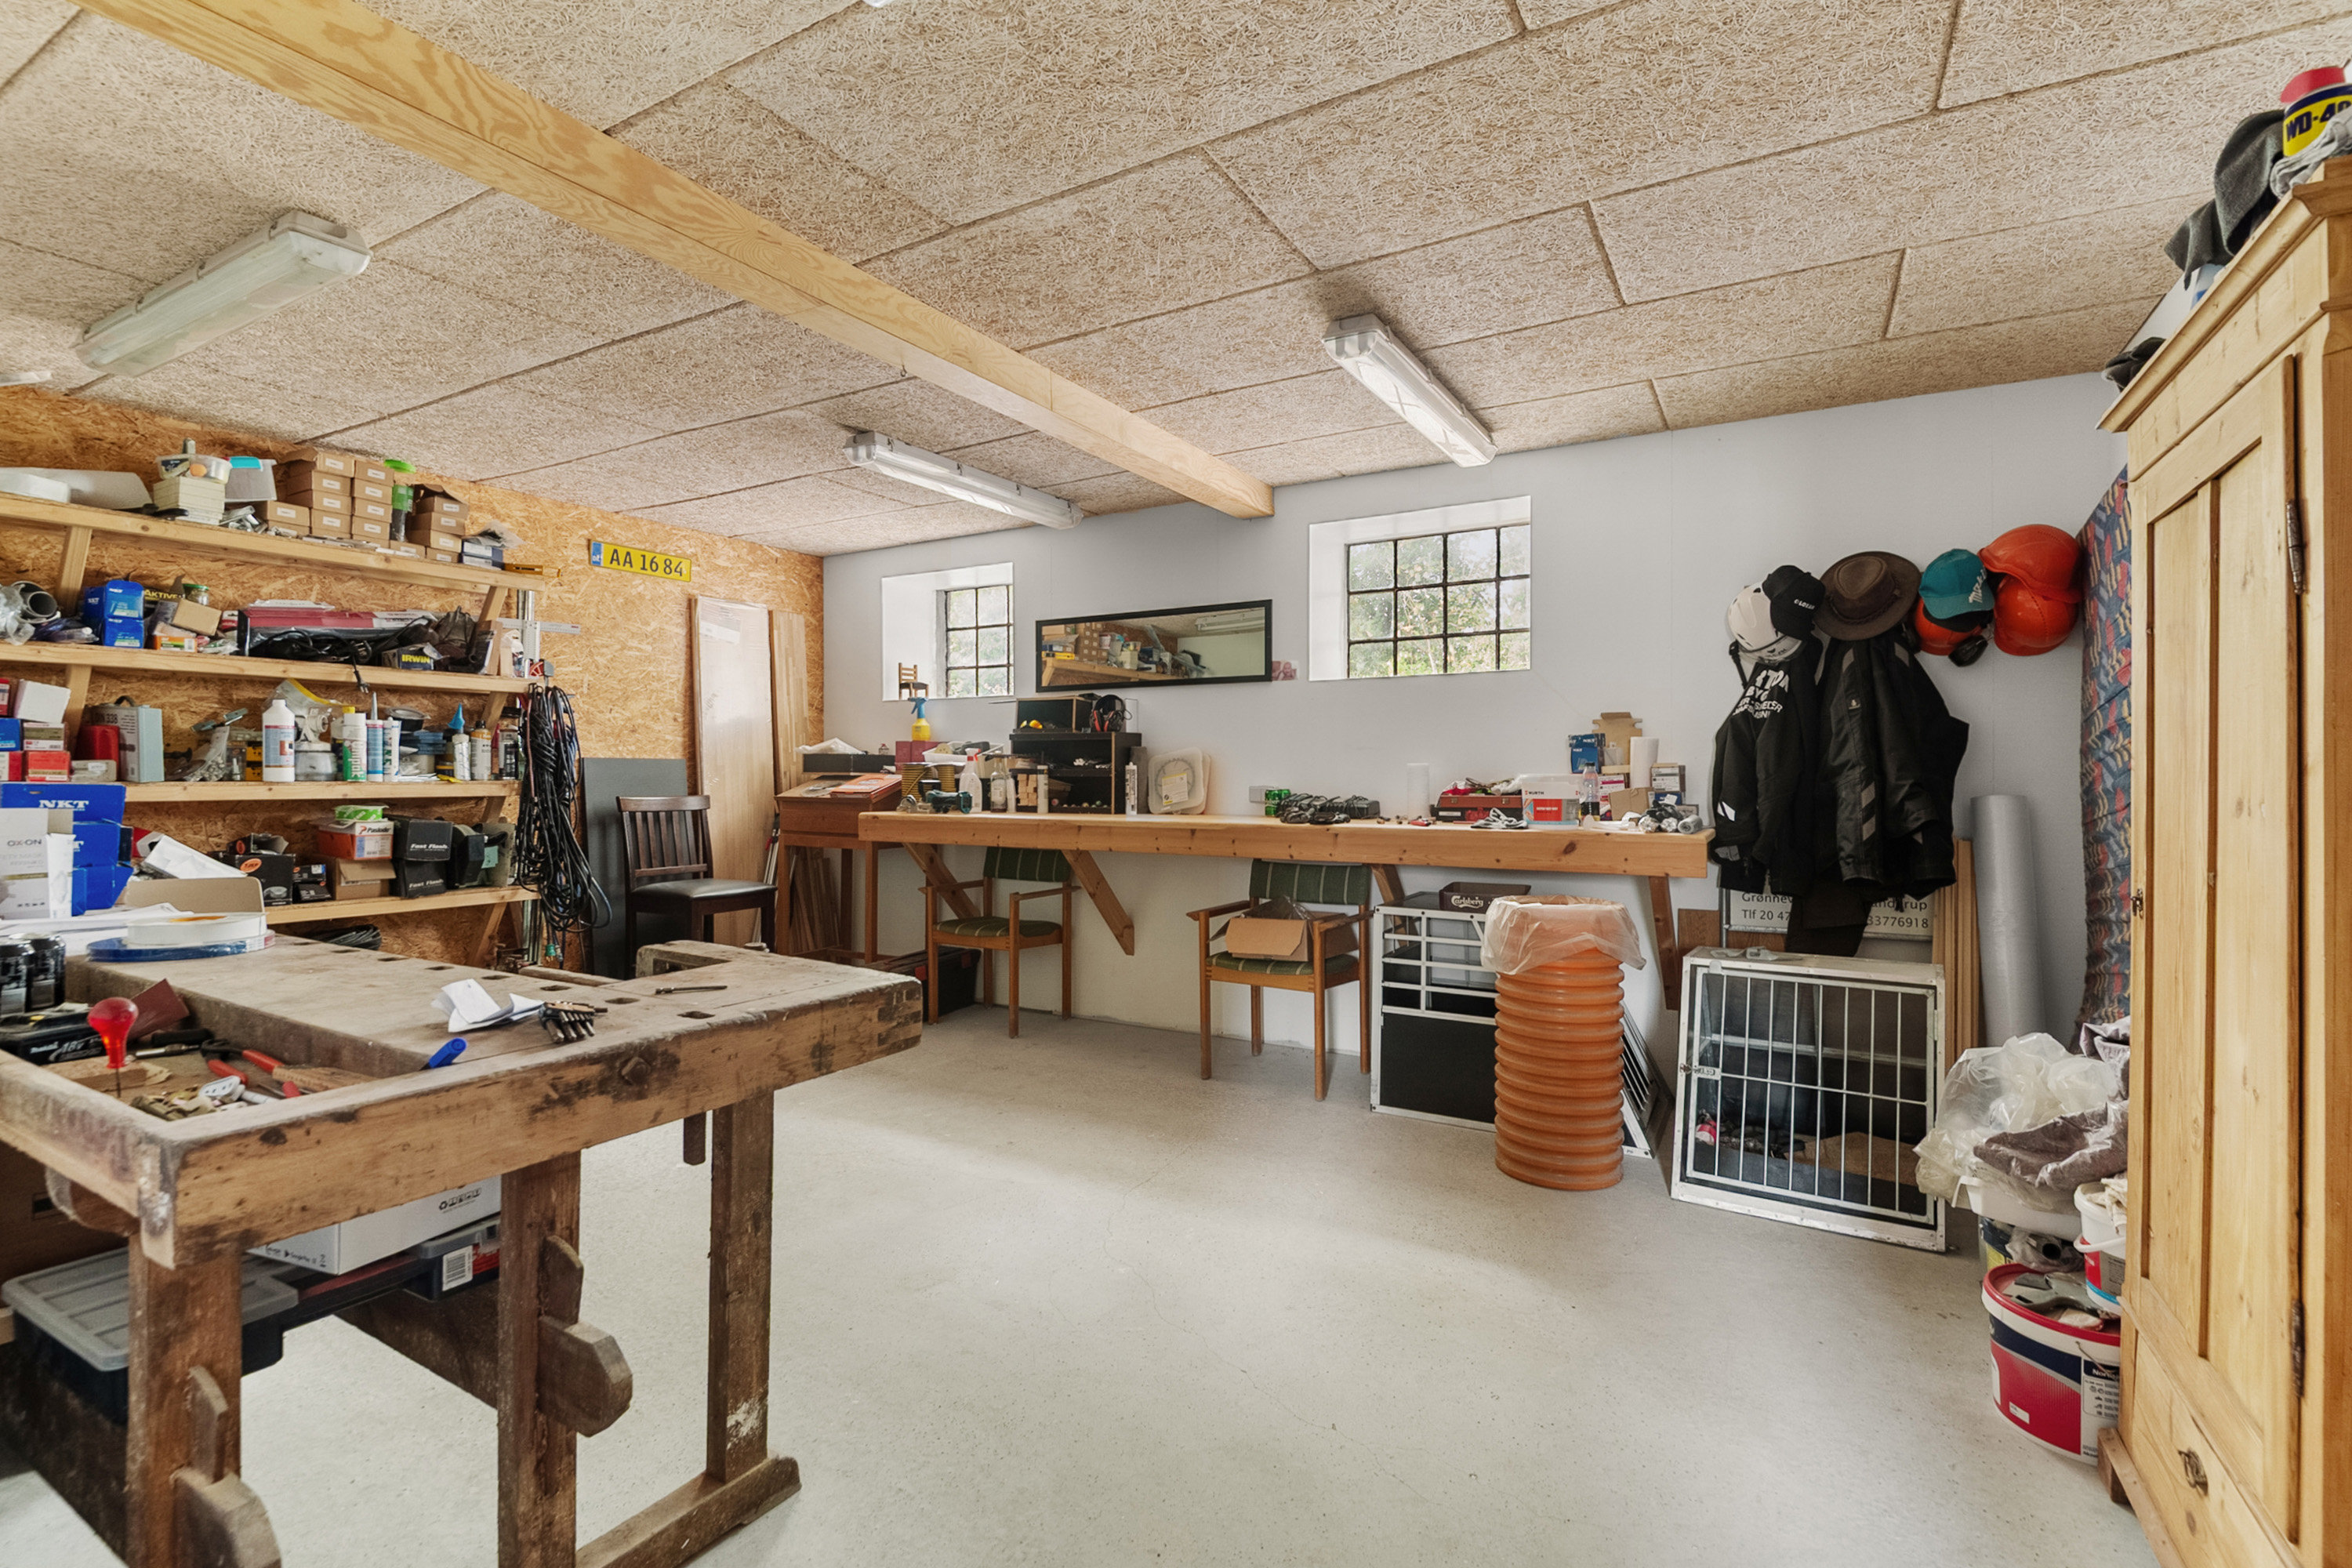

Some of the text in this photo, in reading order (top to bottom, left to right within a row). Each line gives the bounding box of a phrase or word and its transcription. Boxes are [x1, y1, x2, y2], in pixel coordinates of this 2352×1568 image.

[609, 548, 633, 568] AA
[401, 654, 430, 663] IRWIN
[39, 800, 89, 808] NKT
[1451, 895, 1484, 908] Carlsberg
[1741, 909, 1756, 919] Tlf
[1759, 910, 1773, 920] 20
[1777, 911, 1791, 921] 47
